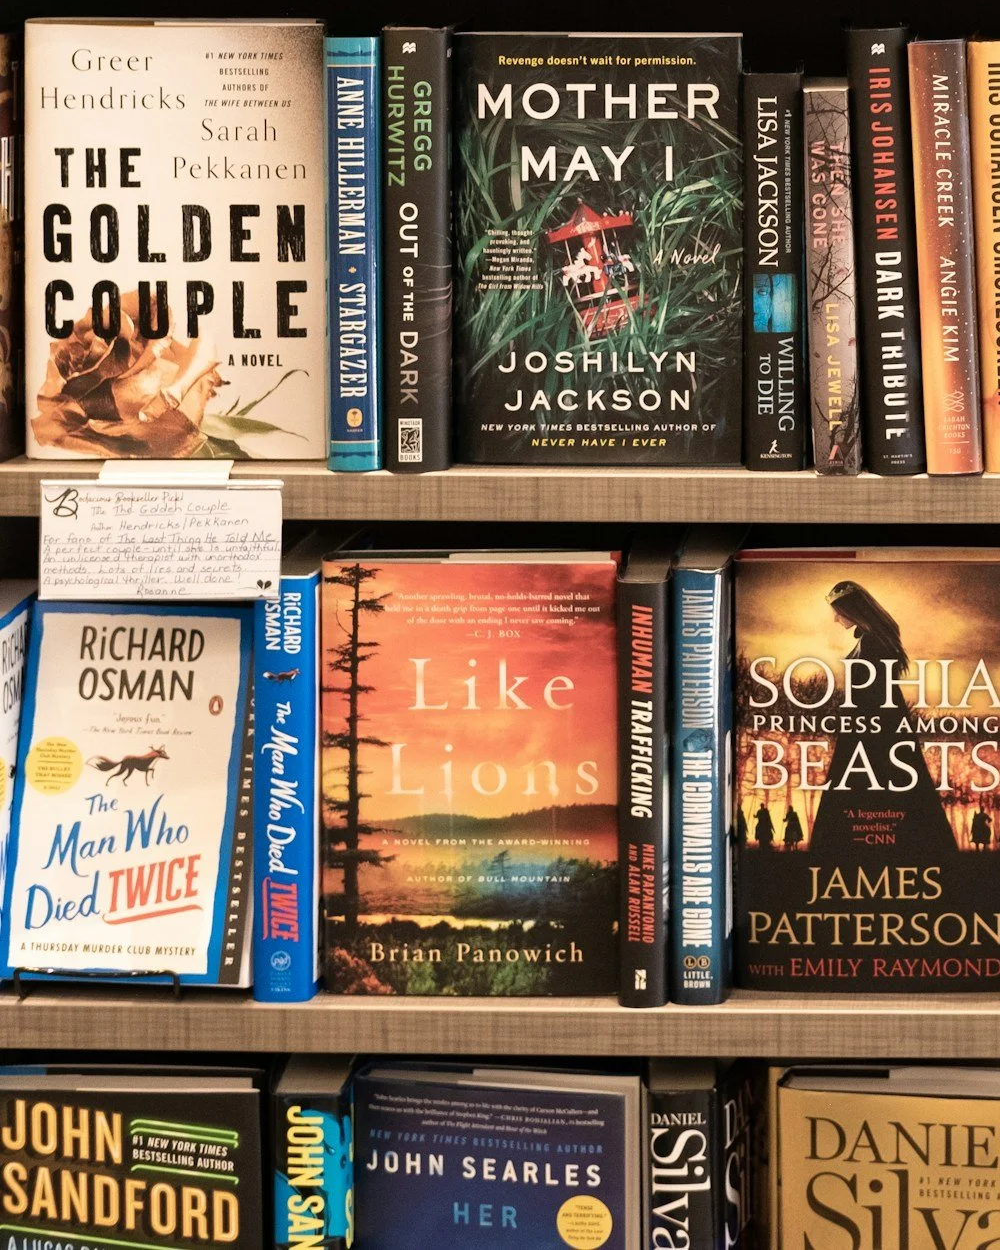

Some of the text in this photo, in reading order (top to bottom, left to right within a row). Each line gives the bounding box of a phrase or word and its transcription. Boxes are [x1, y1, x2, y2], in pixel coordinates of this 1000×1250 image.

[71, 49, 153, 73] Greer
[499, 55, 696, 68] Revenge doesn't wait for permission.
[41, 87, 186, 111] Hendricks
[477, 81, 720, 120] MOTHER
[387, 65, 405, 187] HURWITZ
[413, 80, 431, 172] GREGG
[54, 147, 141, 189] THE
[337, 76, 366, 256] ANNE HILLERMAN
[521, 145, 673, 183] MAY I
[42, 203, 307, 263] GOLDEN
[45, 279, 308, 340] COUPLE
[338, 283, 367, 399] STARGAZER
[875, 251, 908, 440] DARK TRIBUTE
[228, 354, 283, 367] A NOVEL
[498, 350, 697, 375] JOSHILYN
[505, 389, 691, 411] JACKSON
[78, 668, 194, 702] OSMAN
[753, 714, 1000, 735] PRINCESS AMONG
[807, 865, 943, 903] JAMES
[20, 941, 196, 956] A THURSDAY MURDER CLUB MYSTERY
[2, 1100, 122, 1164] JOHN
[366, 1150, 602, 1187] JOHN SEARLES
[2, 1164, 241, 1243] SANDFORD
